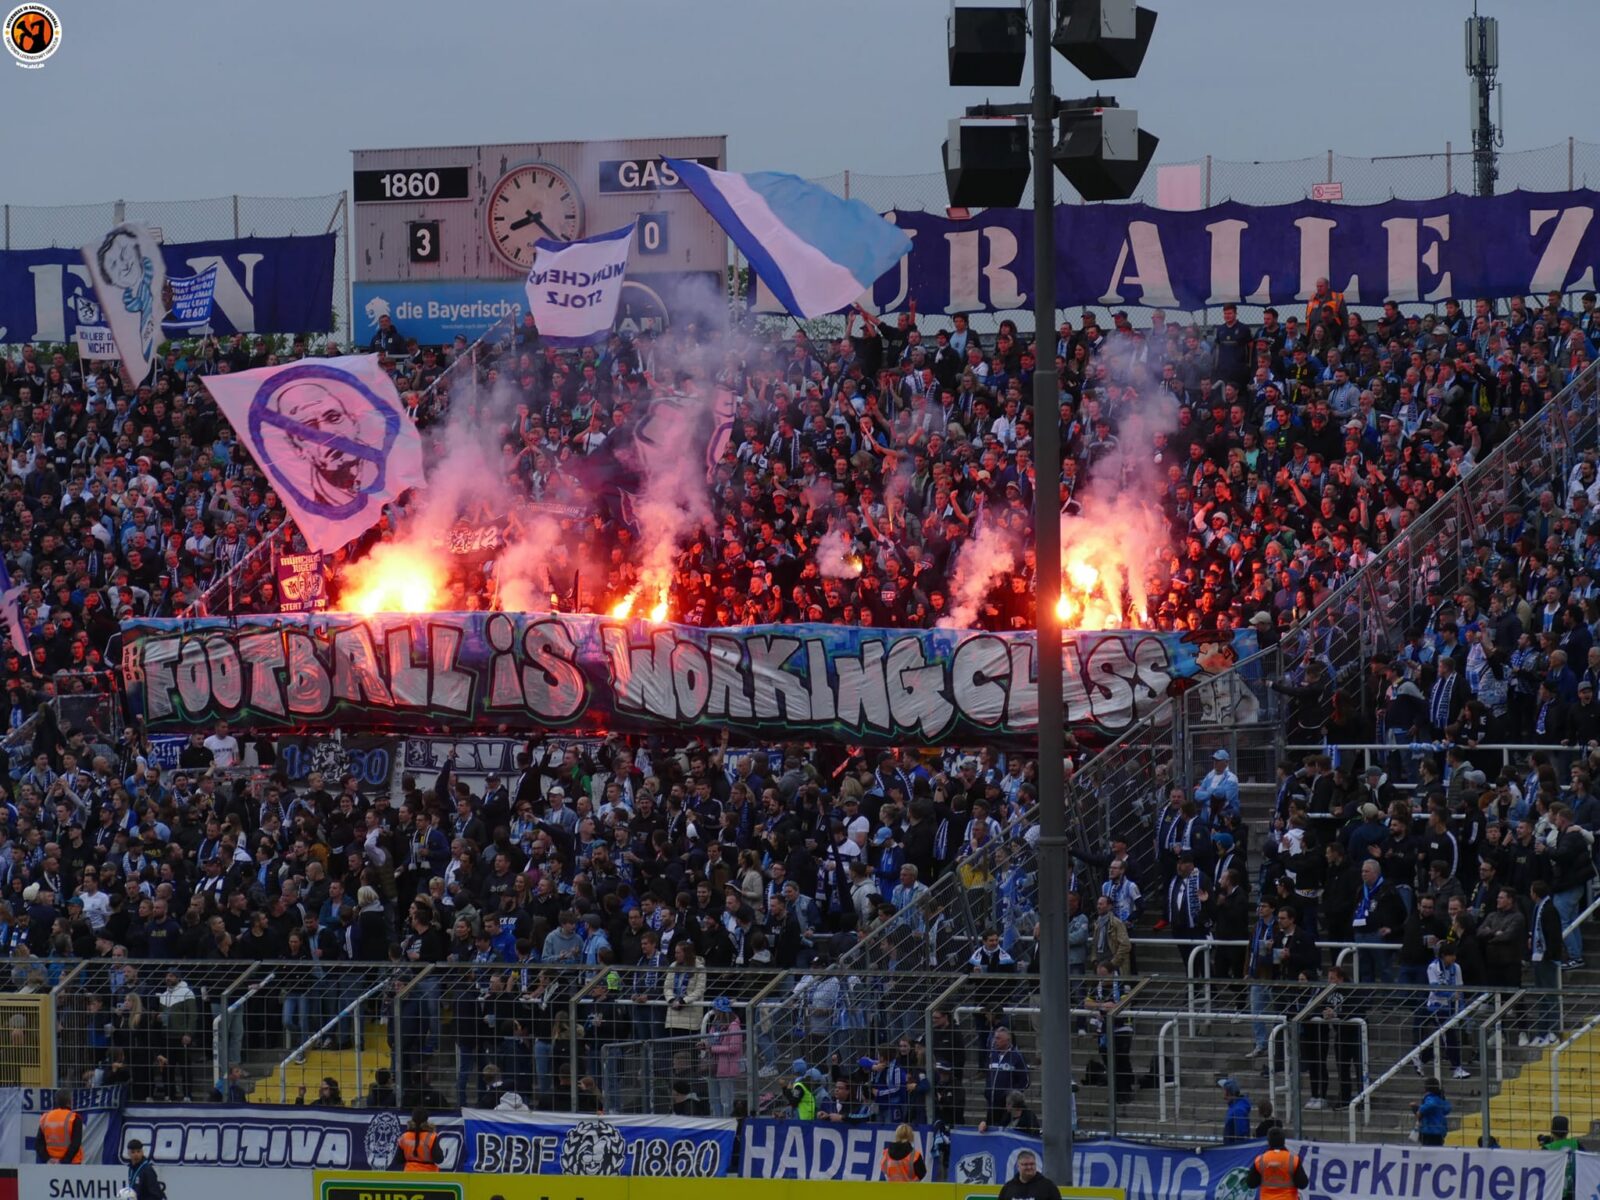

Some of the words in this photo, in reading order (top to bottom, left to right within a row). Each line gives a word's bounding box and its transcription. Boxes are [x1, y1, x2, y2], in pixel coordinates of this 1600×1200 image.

[380, 172, 440, 197] 1860
[618, 159, 697, 188] GAS
[416, 228, 431, 256] 3
[644, 221, 659, 249] 0
[1097, 214, 1452, 308] ALLE
[181, 306, 208, 319] 1860!
[396, 302, 423, 319] die
[428, 300, 522, 321] Bayerische
[142, 623, 478, 720] FOOTBALL
[600, 624, 954, 740] WORKING
[431, 742, 504, 769] TSV
[40, 1086, 120, 1110] BIBEN!
[474, 1133, 559, 1174] BBF
[627, 1138, 721, 1177] 1860
[49, 1178, 167, 1200] SAMHUR
